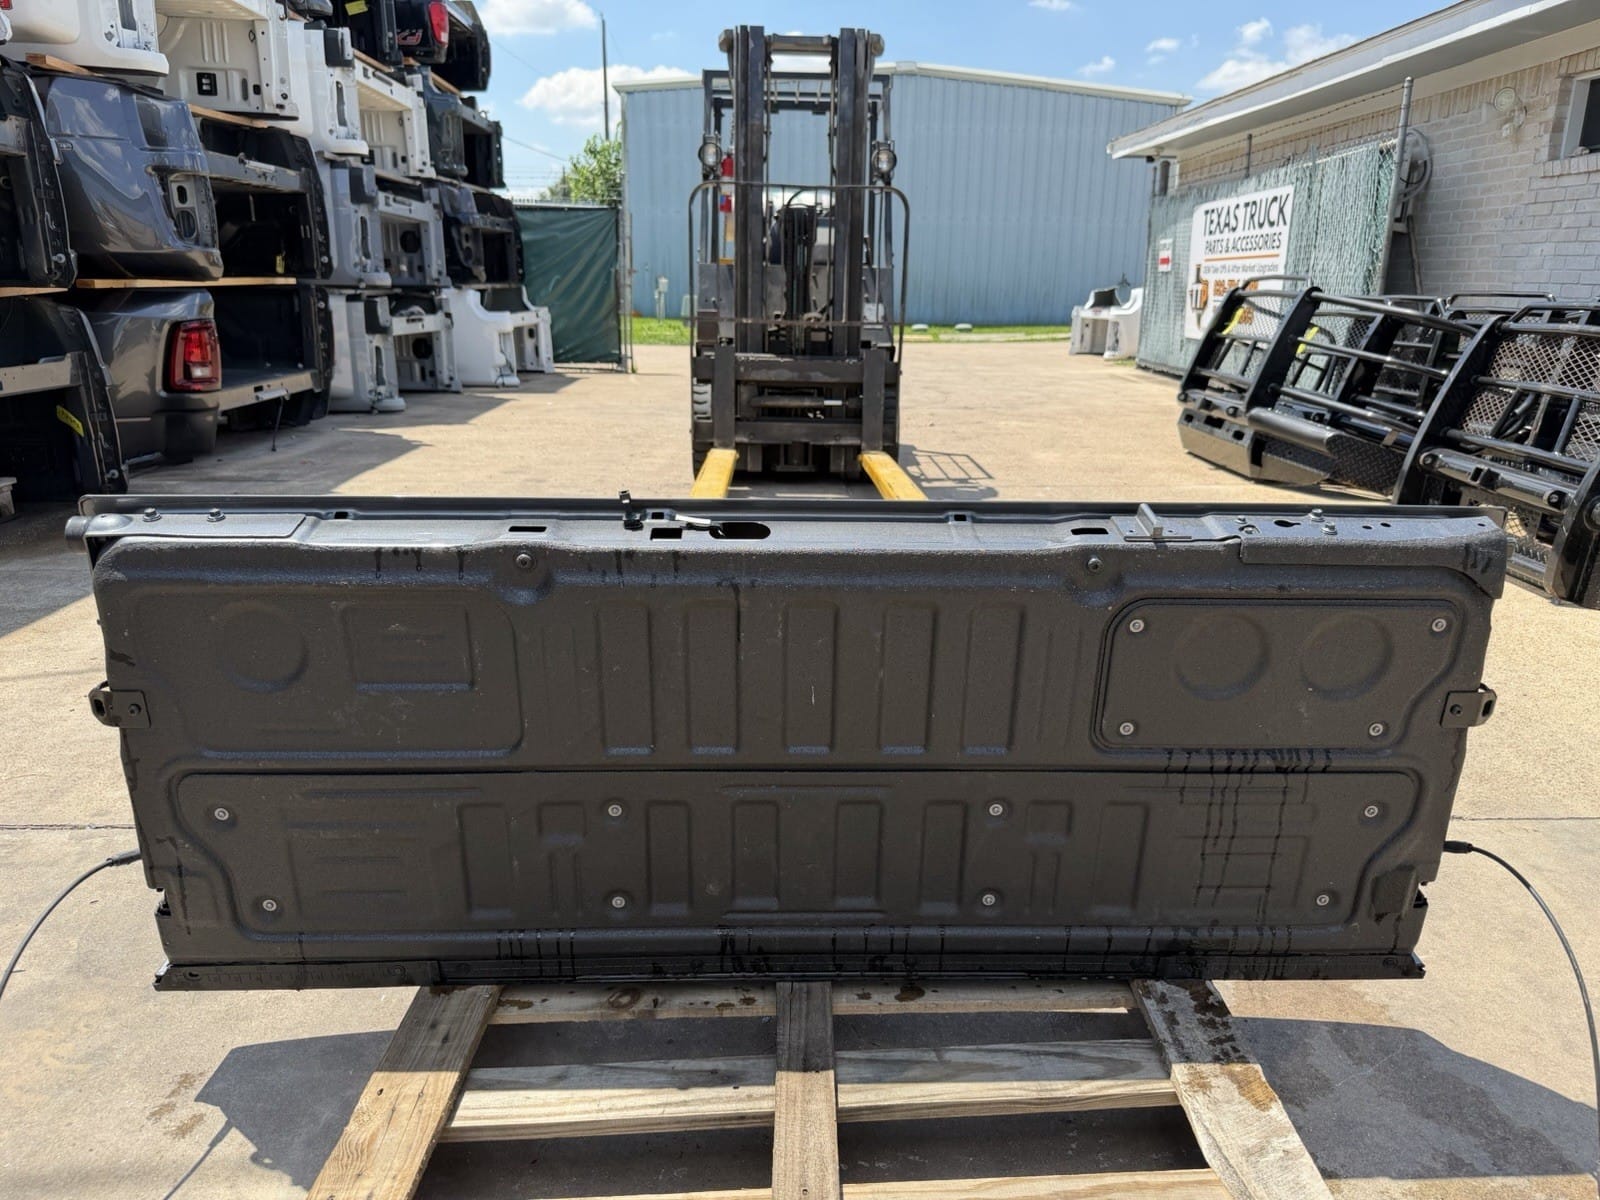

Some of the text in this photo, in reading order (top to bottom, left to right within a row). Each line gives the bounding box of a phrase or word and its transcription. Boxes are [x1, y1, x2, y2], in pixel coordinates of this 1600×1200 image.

[1204, 193, 1289, 237] TEXAS TRUCK
[1205, 232, 1281, 255] PARTS & ACCESSORIES
